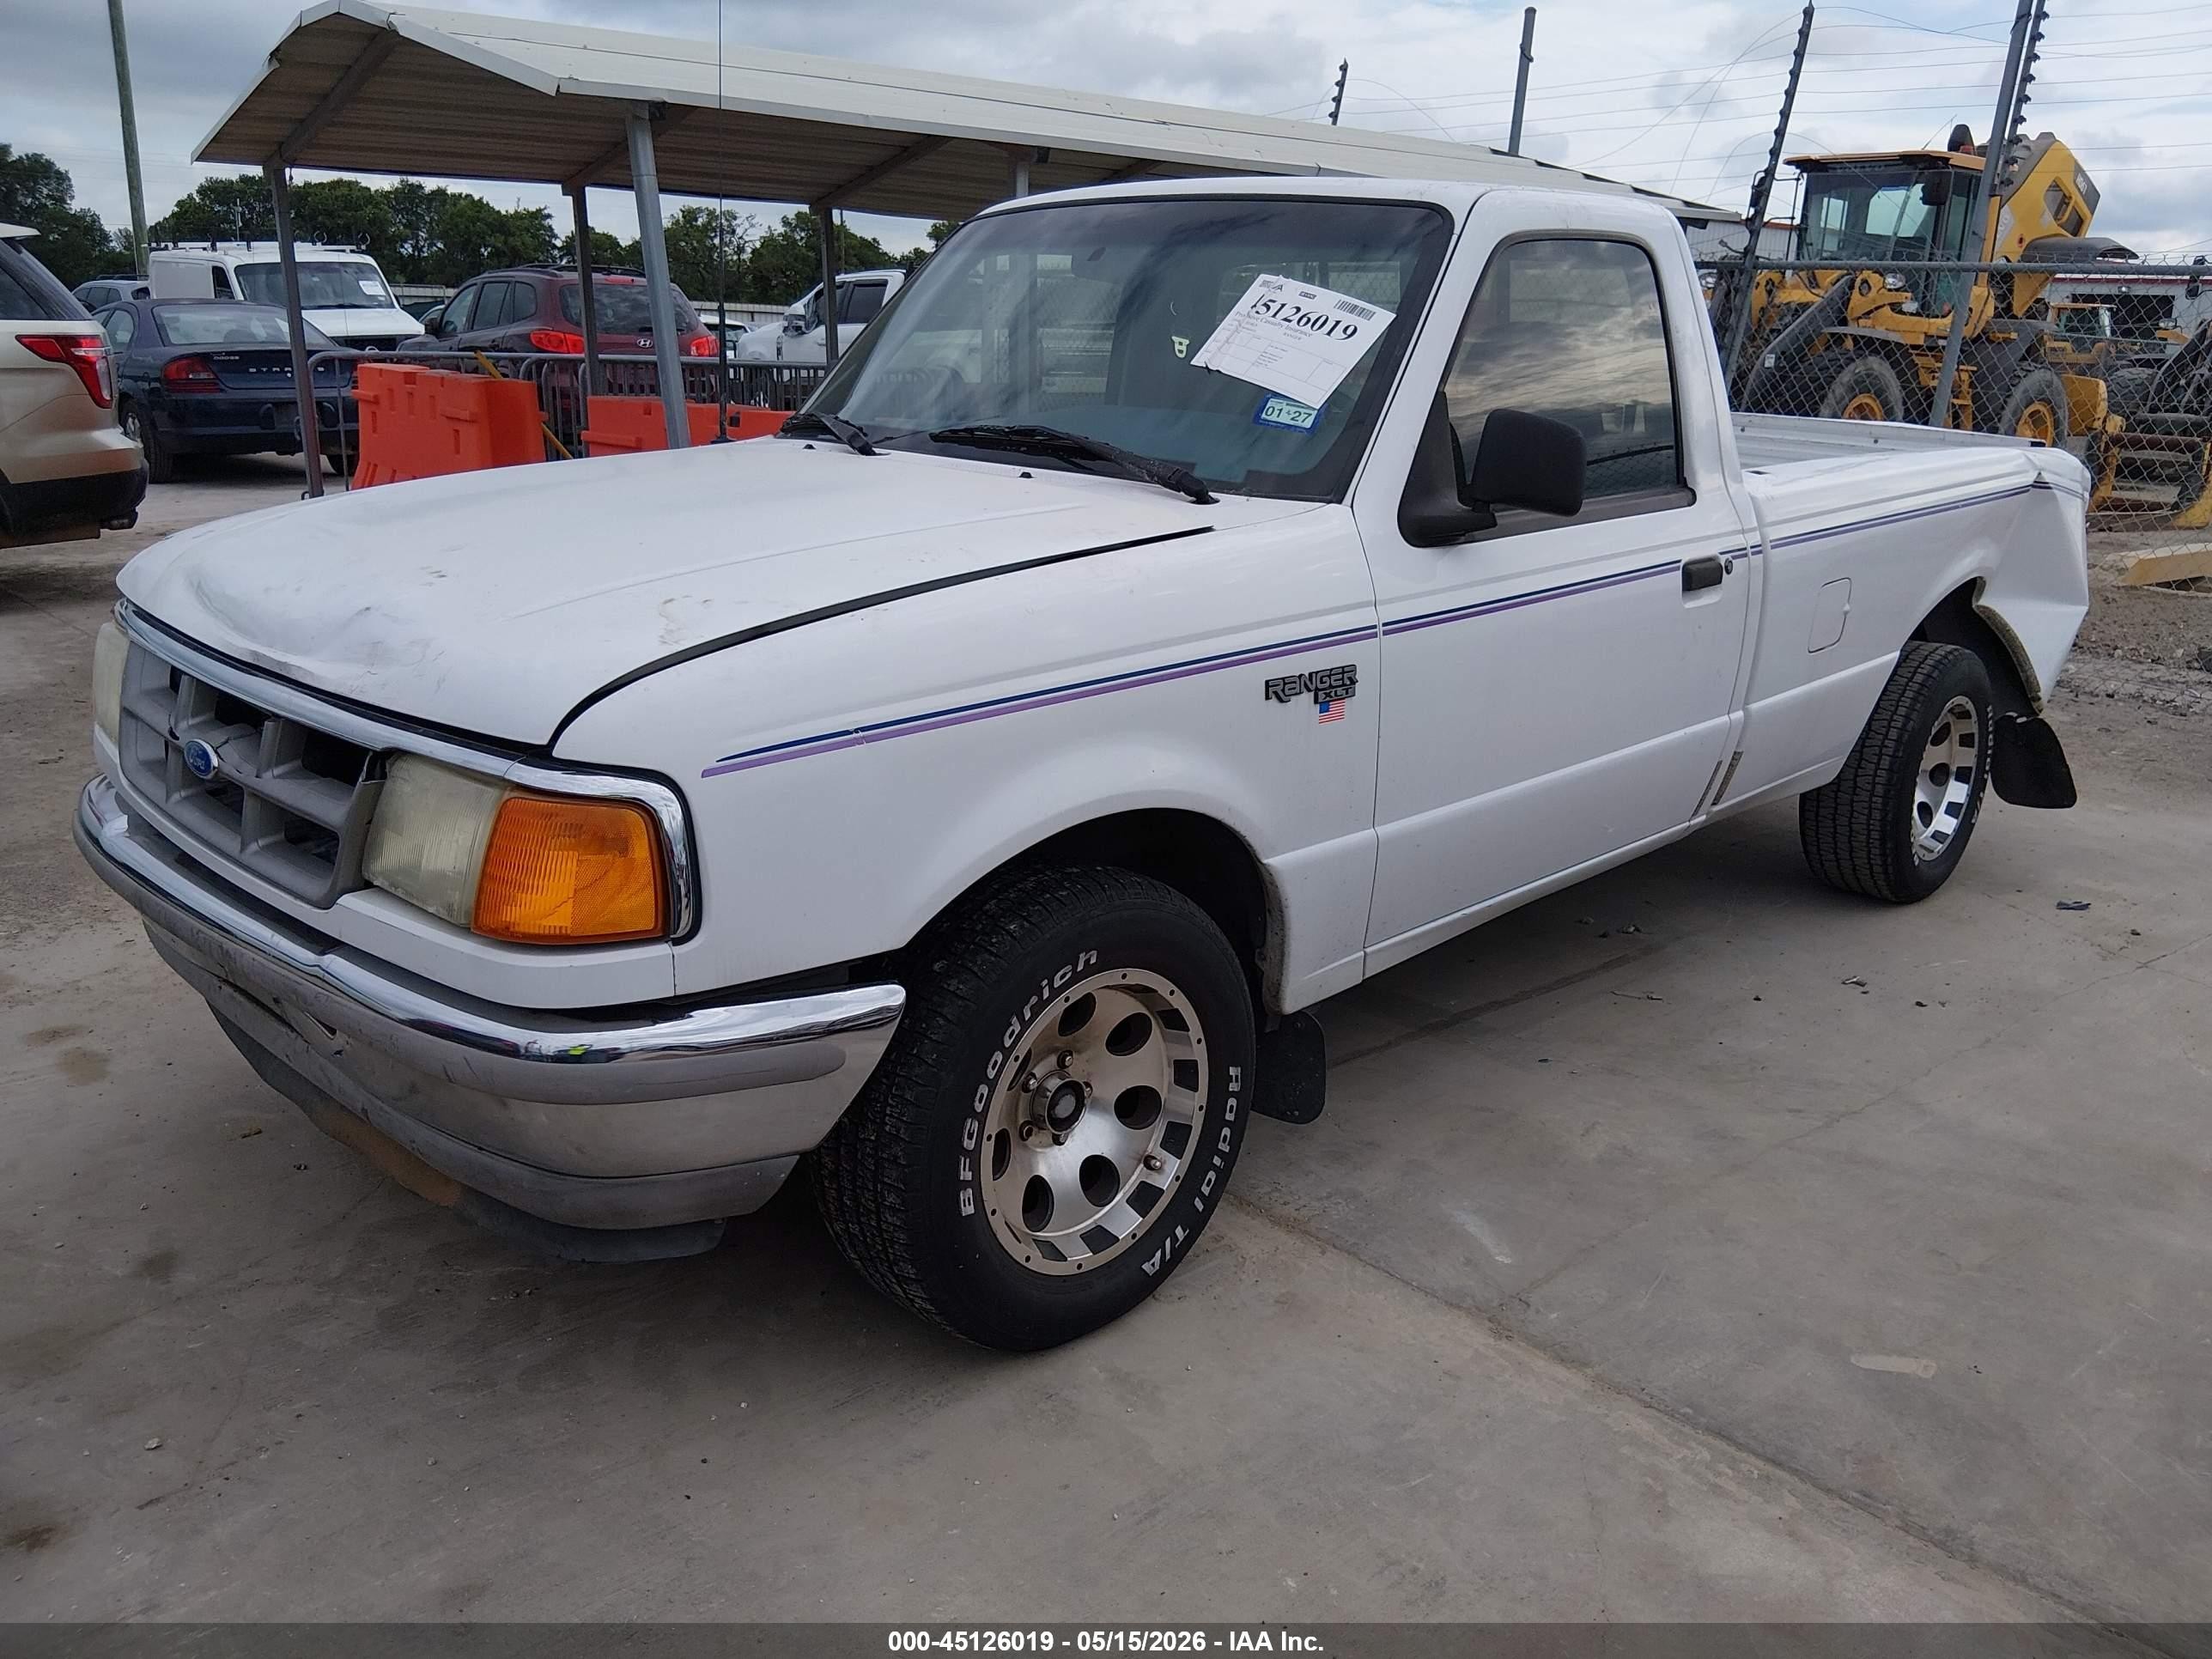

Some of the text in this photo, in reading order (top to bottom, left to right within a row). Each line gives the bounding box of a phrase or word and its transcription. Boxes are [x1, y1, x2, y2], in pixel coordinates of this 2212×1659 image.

[1265, 405, 1313, 423] 01 27
[1322, 686, 1353, 701] XLT
[958, 949, 1099, 1217] BFGoodrich
[1141, 1066, 1242, 1277] Radial T/A
